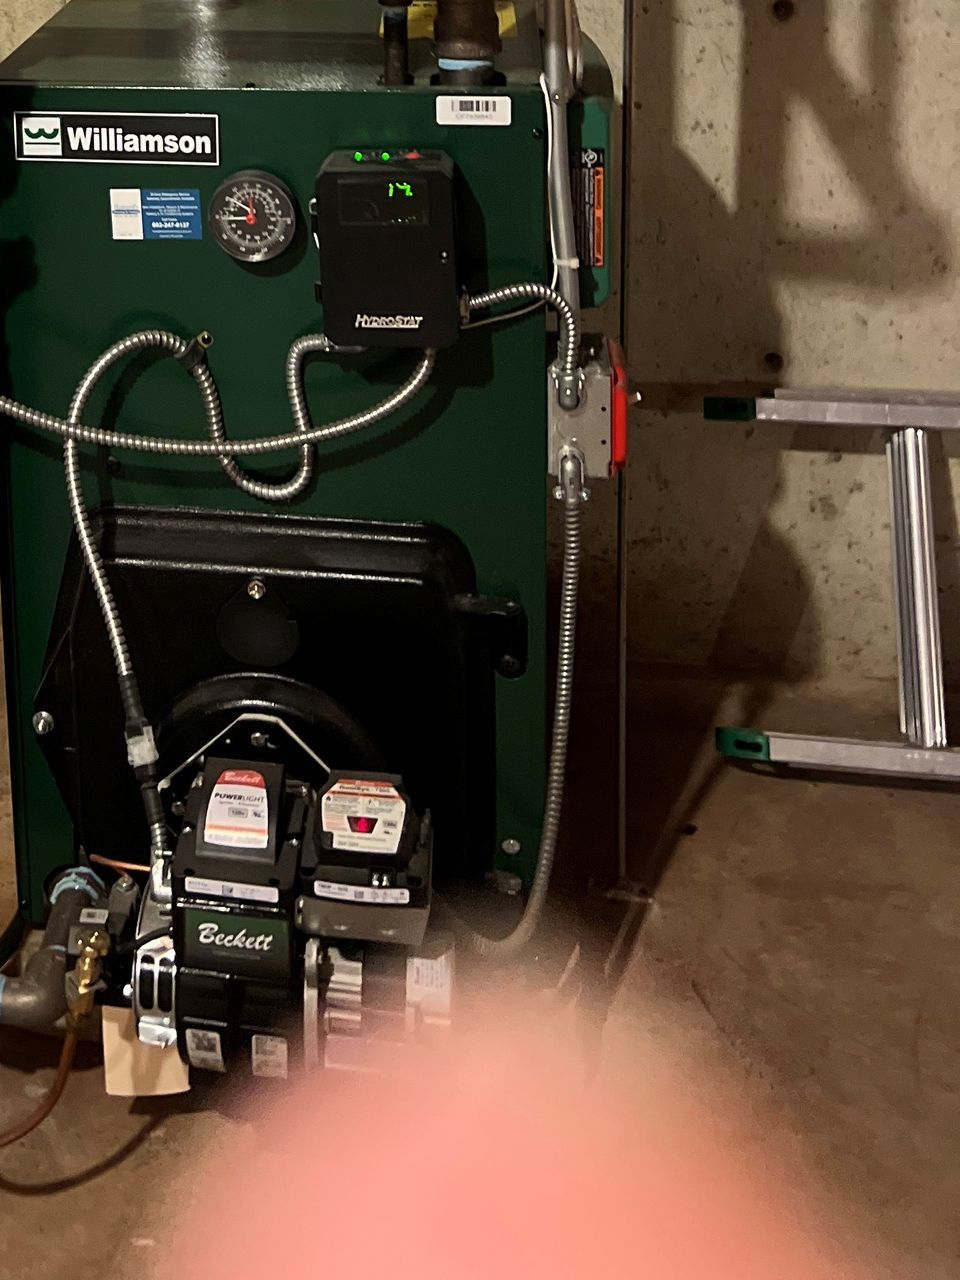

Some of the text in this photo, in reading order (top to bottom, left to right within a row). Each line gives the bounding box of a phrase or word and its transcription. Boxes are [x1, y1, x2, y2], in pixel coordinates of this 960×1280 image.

[67, 126, 212, 154] Williamson
[214, 792, 265, 803] POWERLIGHT
[198, 922, 274, 951] Beckett
